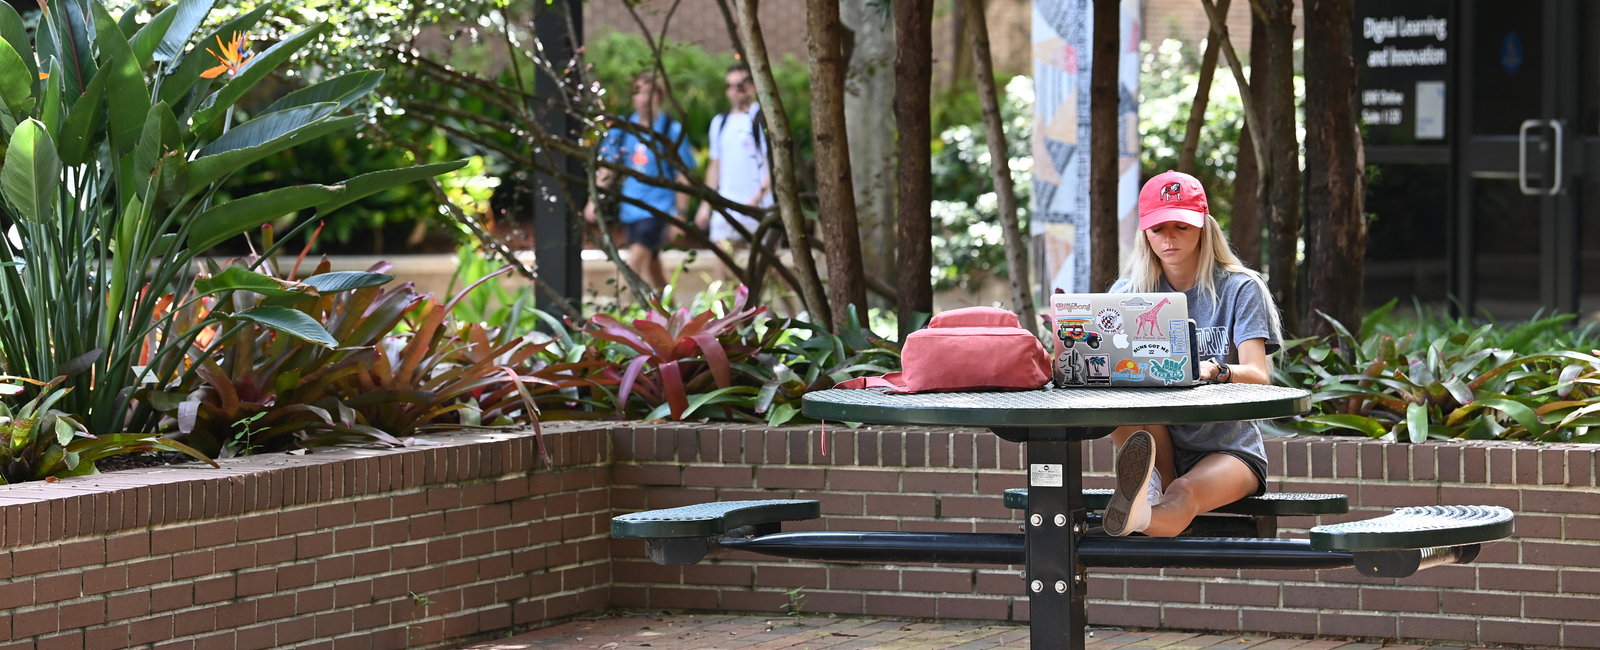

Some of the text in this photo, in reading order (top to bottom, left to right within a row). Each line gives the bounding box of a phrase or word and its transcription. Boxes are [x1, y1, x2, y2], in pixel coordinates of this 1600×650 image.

[1363, 17, 1447, 43] Digital Learning
[1367, 46, 1447, 67] and Innovation
